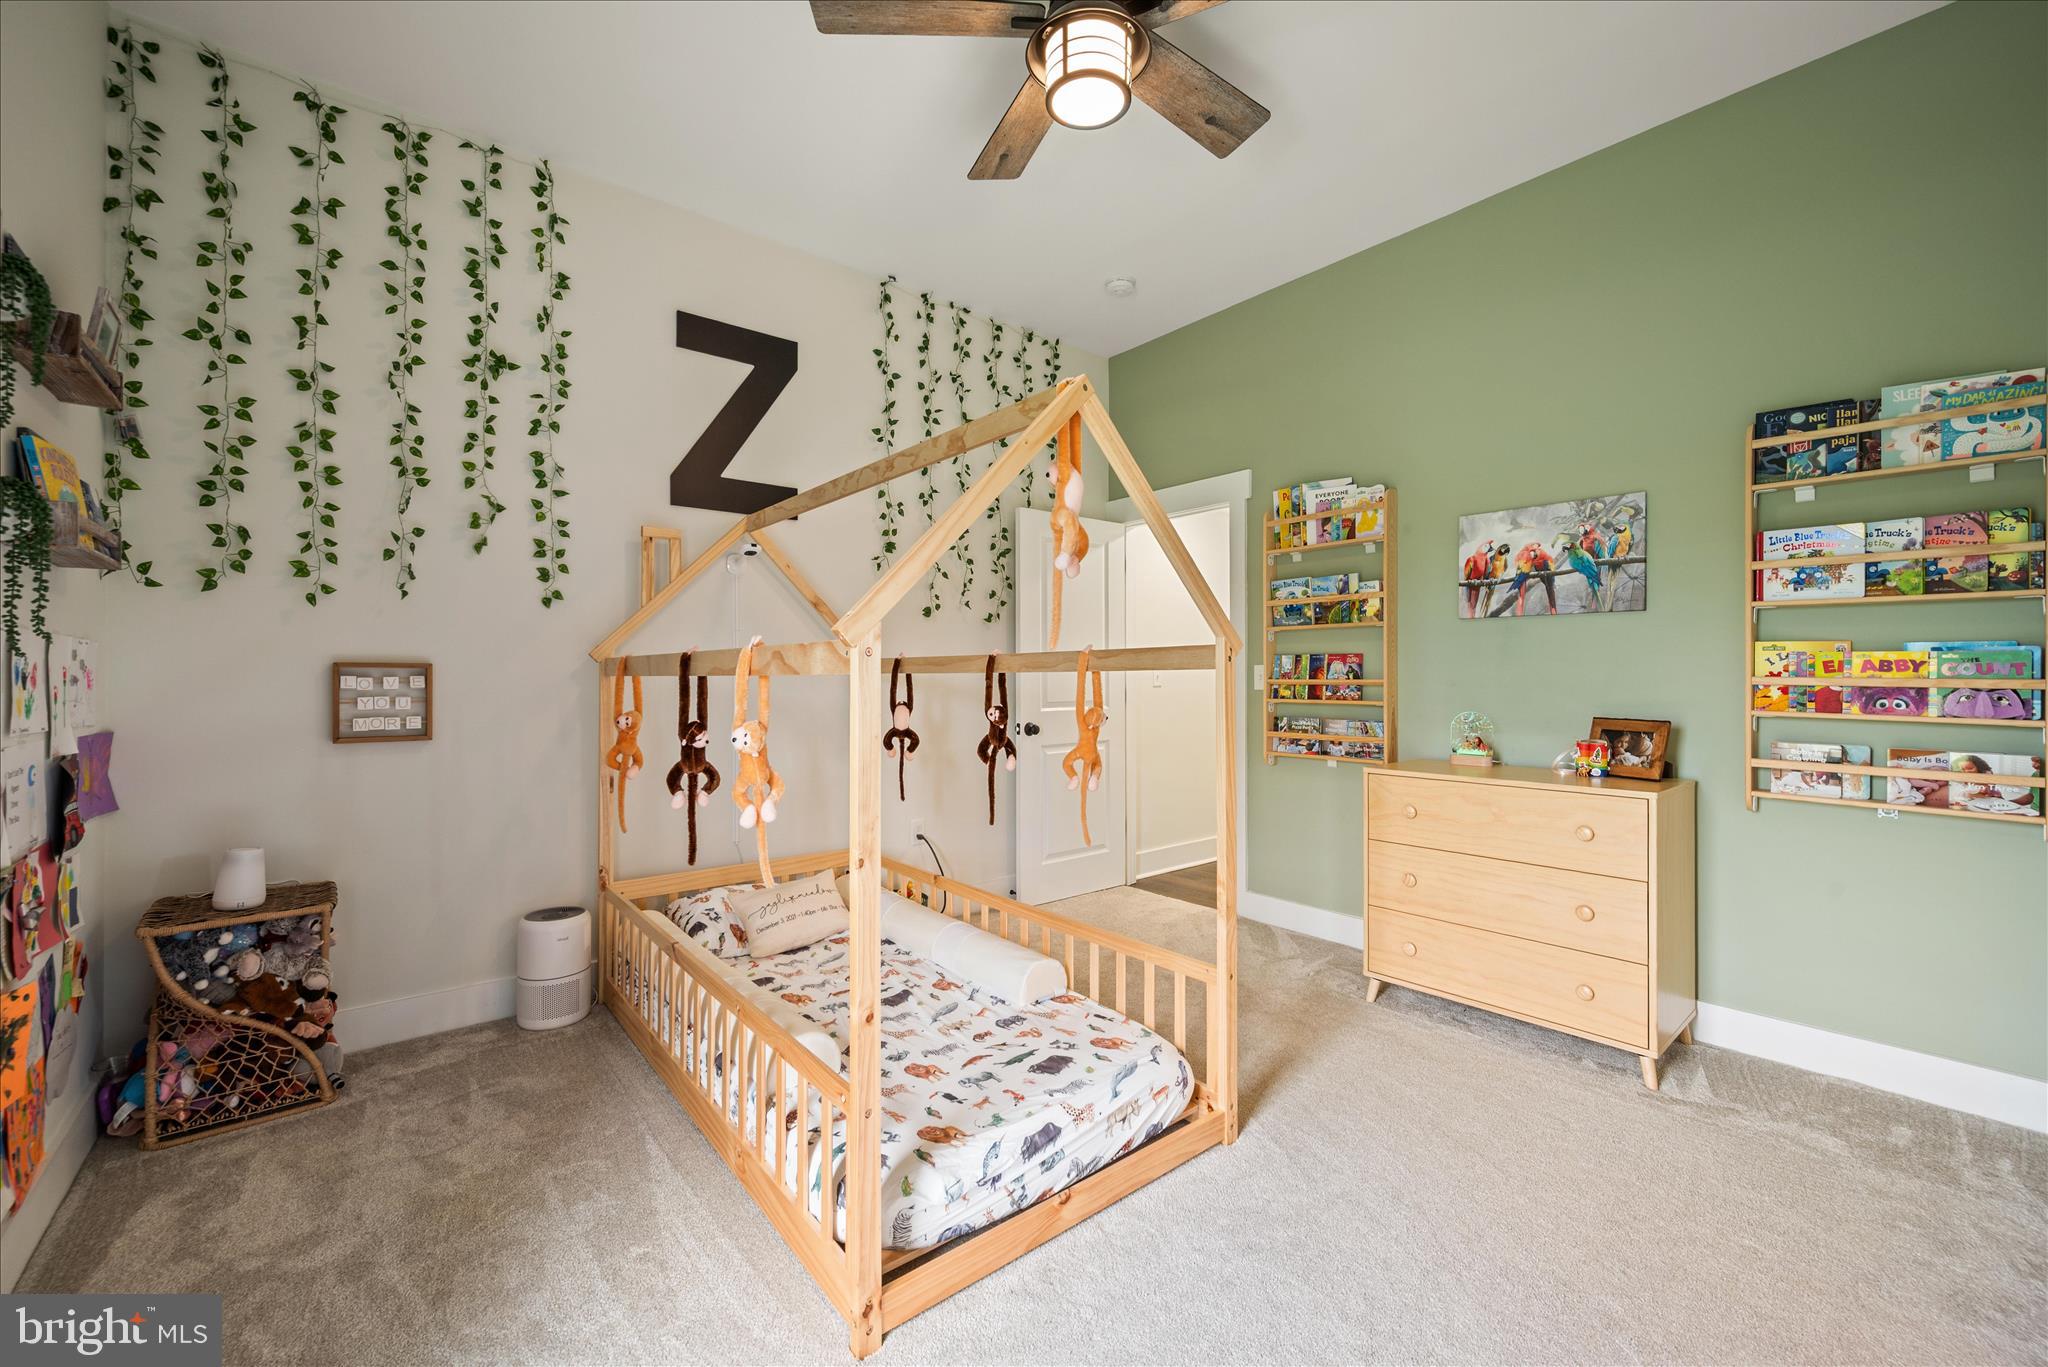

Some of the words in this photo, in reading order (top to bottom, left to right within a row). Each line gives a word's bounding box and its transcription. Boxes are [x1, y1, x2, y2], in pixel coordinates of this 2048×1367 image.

[670, 310, 798, 520] Z
[1315, 490, 1349, 499] EVERYONE
[1874, 526, 1912, 537] Truck's
[1934, 526, 1975, 537] Truck's
[1769, 536, 1793, 546] Little
[1794, 532, 1814, 542] Blue
[1860, 659, 1927, 673] ABBY
[1941, 662, 2026, 676] COUNT
[344, 677, 423, 690] LOVE
[360, 697, 409, 709] YOU
[354, 717, 420, 730] MORE
